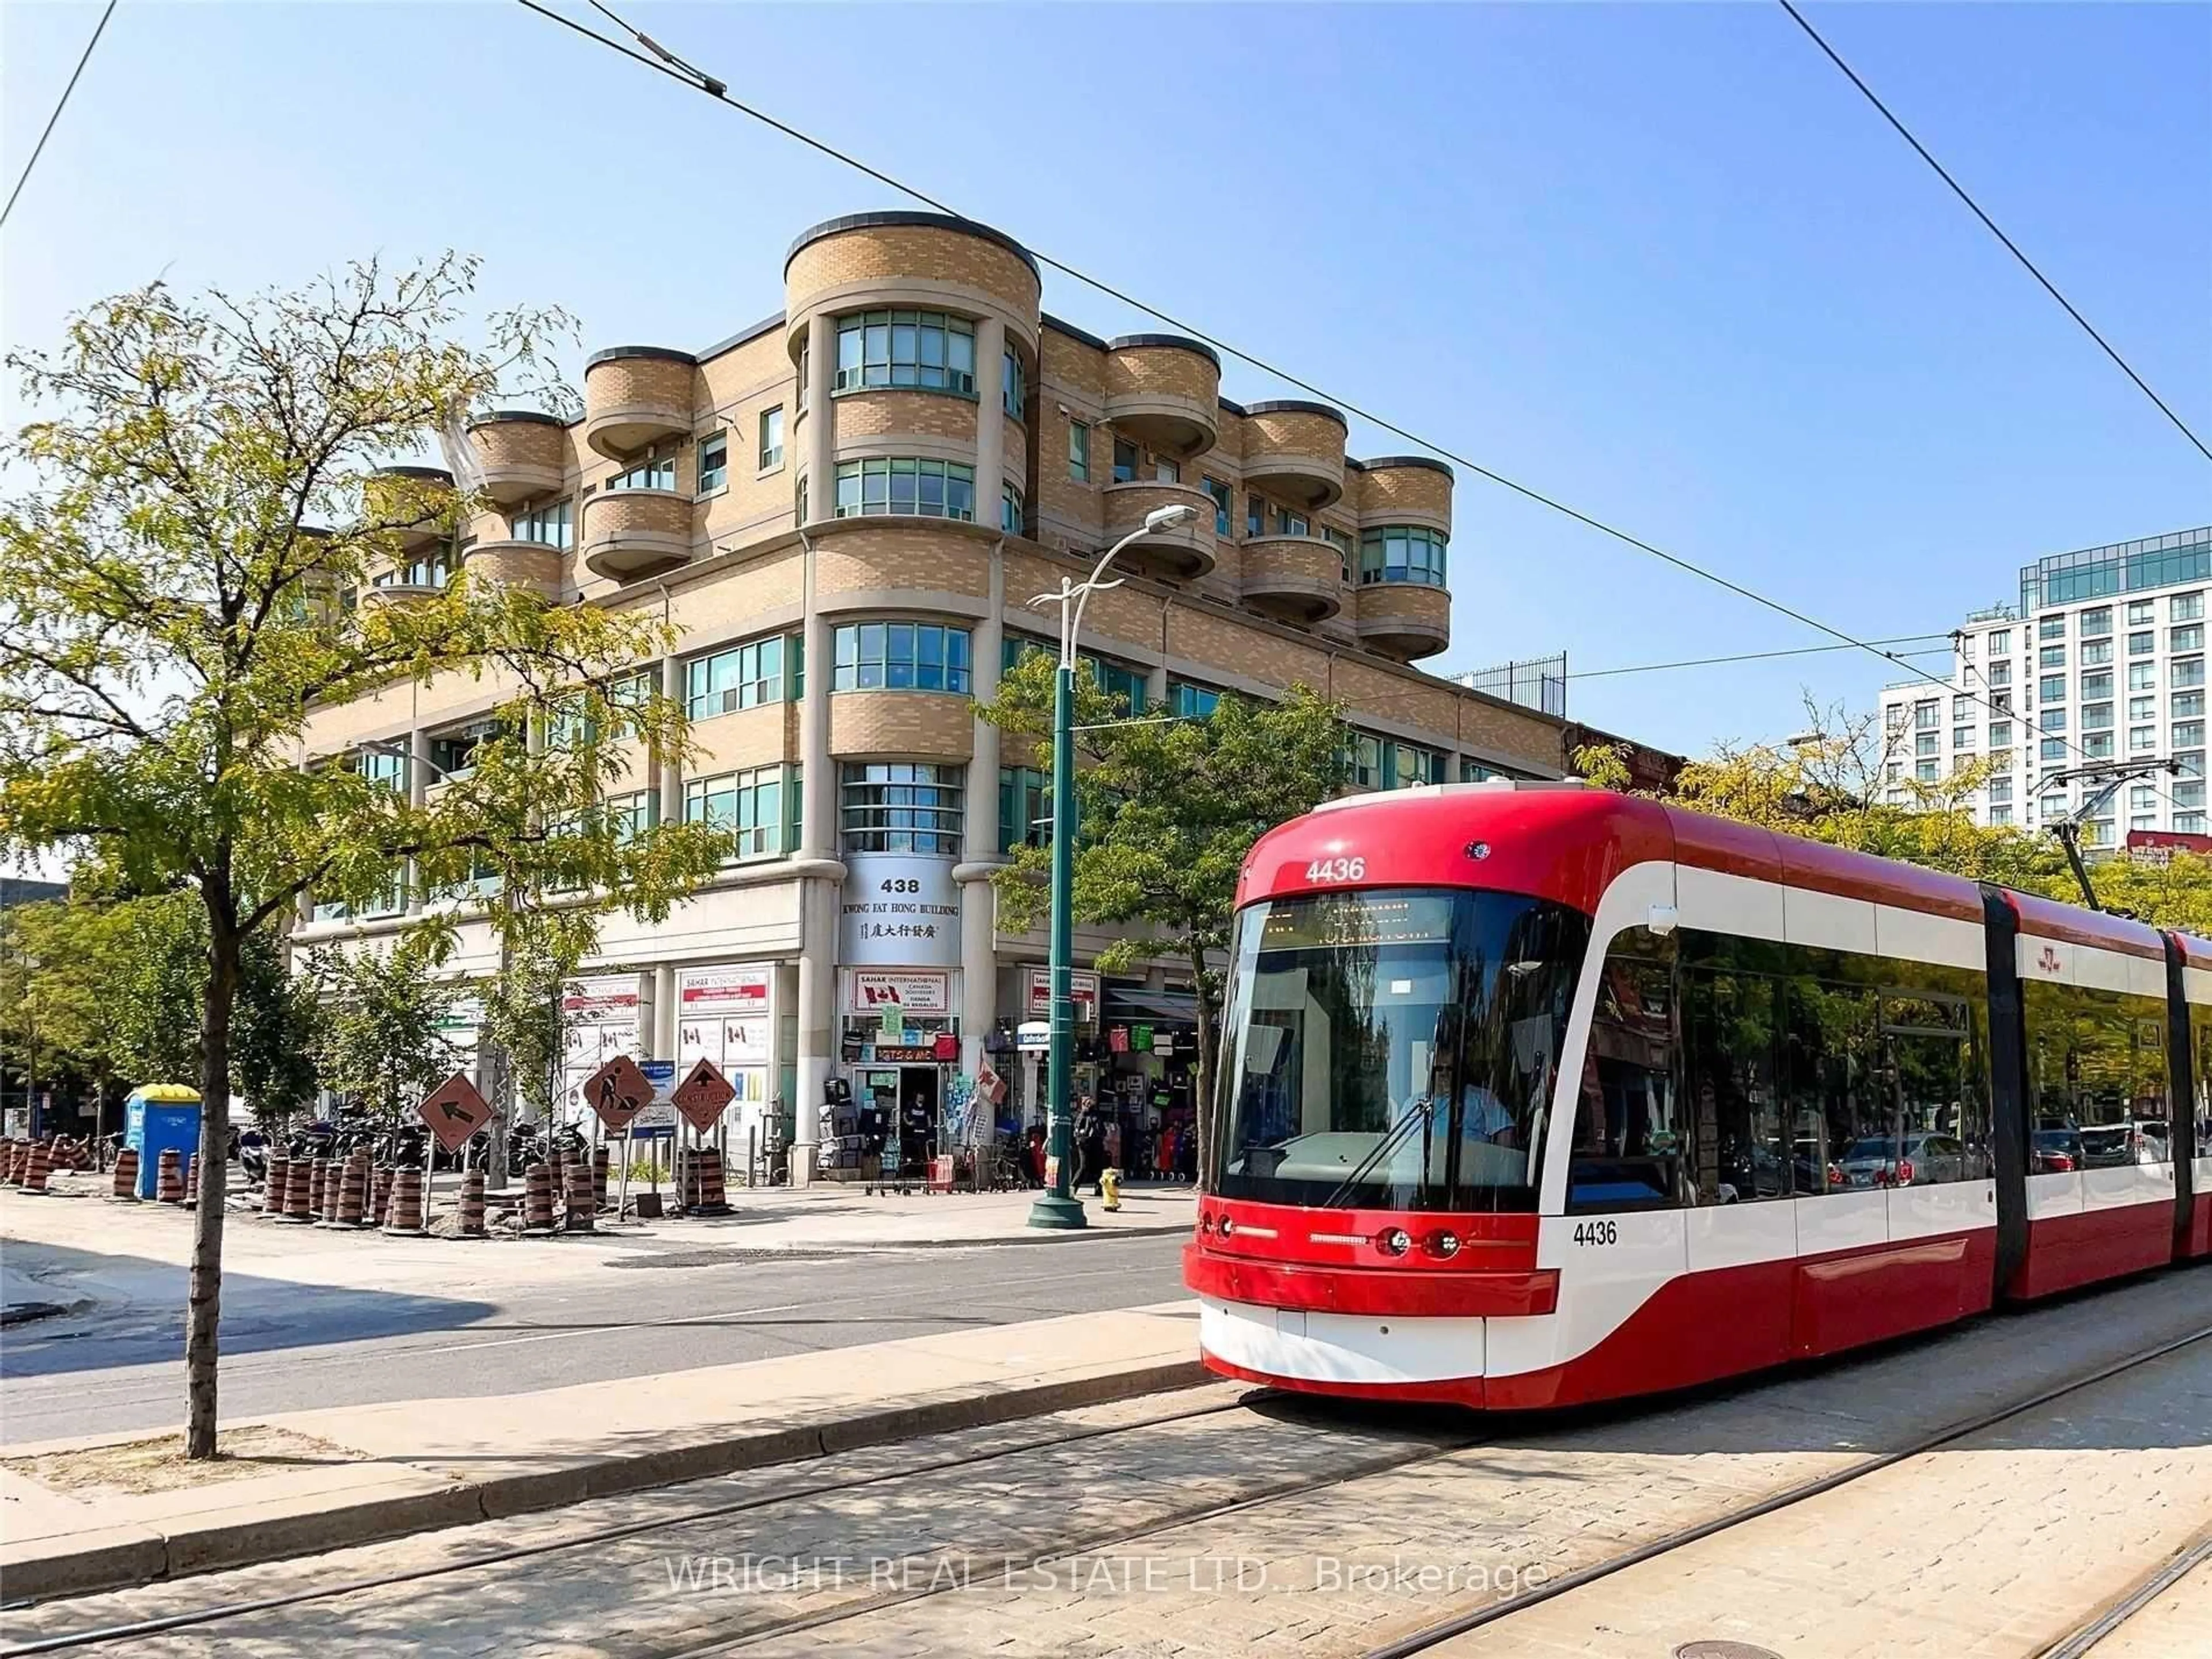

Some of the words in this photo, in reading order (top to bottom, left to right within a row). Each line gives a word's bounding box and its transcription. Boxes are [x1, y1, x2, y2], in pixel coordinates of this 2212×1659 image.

[1306, 857, 1365, 882] 4436
[880, 879, 920, 893] 438
[873, 903, 888, 913] FAT
[891, 903, 916, 914] HONG
[920, 904, 959, 916] BUILDING
[1574, 1221, 1617, 1247] 4436
